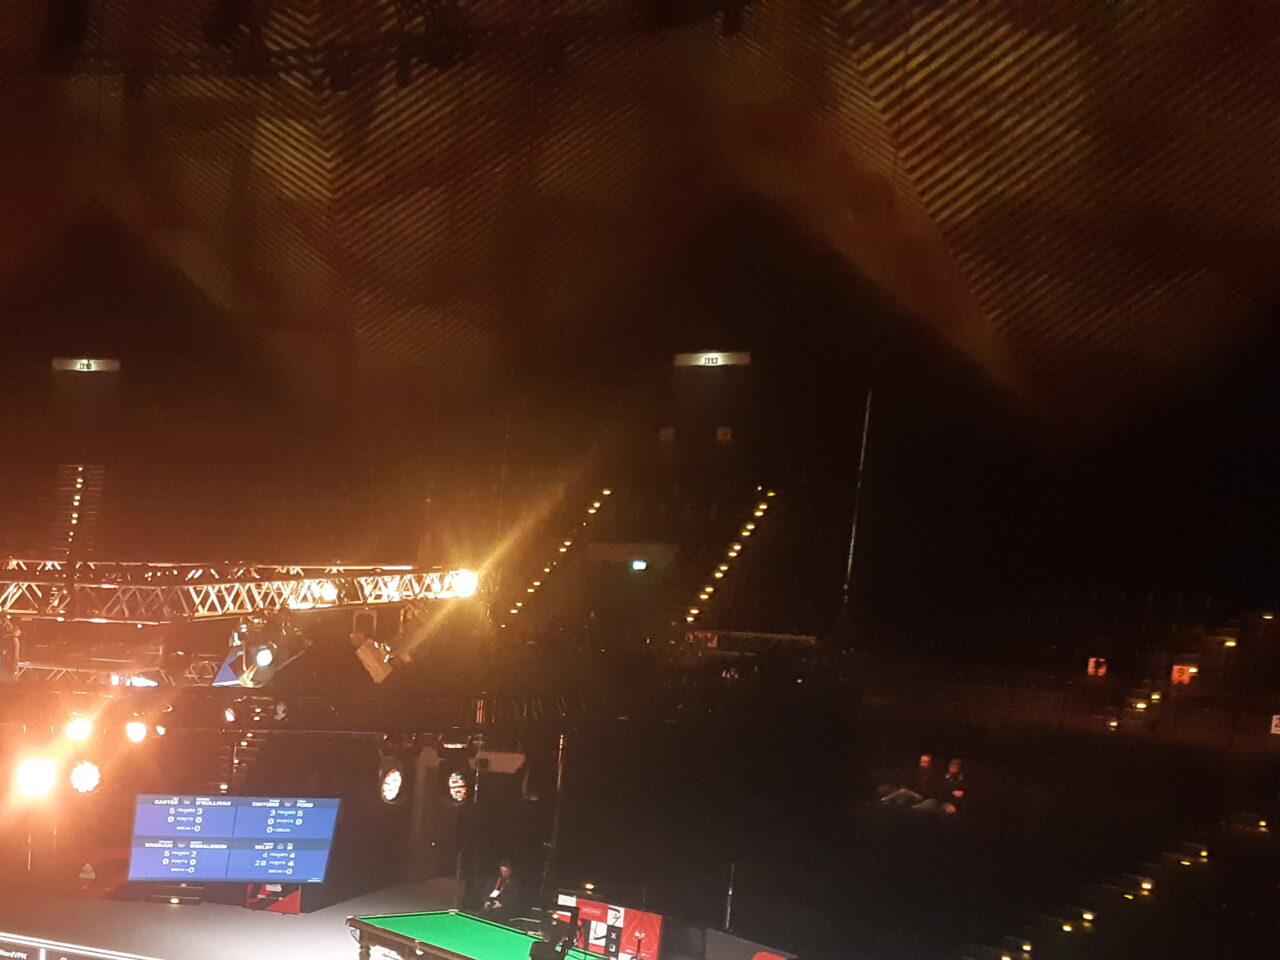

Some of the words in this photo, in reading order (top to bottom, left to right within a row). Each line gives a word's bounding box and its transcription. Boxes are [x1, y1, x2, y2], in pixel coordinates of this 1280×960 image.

[270, 809, 276, 817] 3
[195, 816, 202, 824] 0
[295, 818, 303, 826] 0
[266, 826, 273, 834] 0
[190, 850, 197, 858] 2
[189, 858, 197, 866] 0
[0, 949, 28, 960] NordVPN
